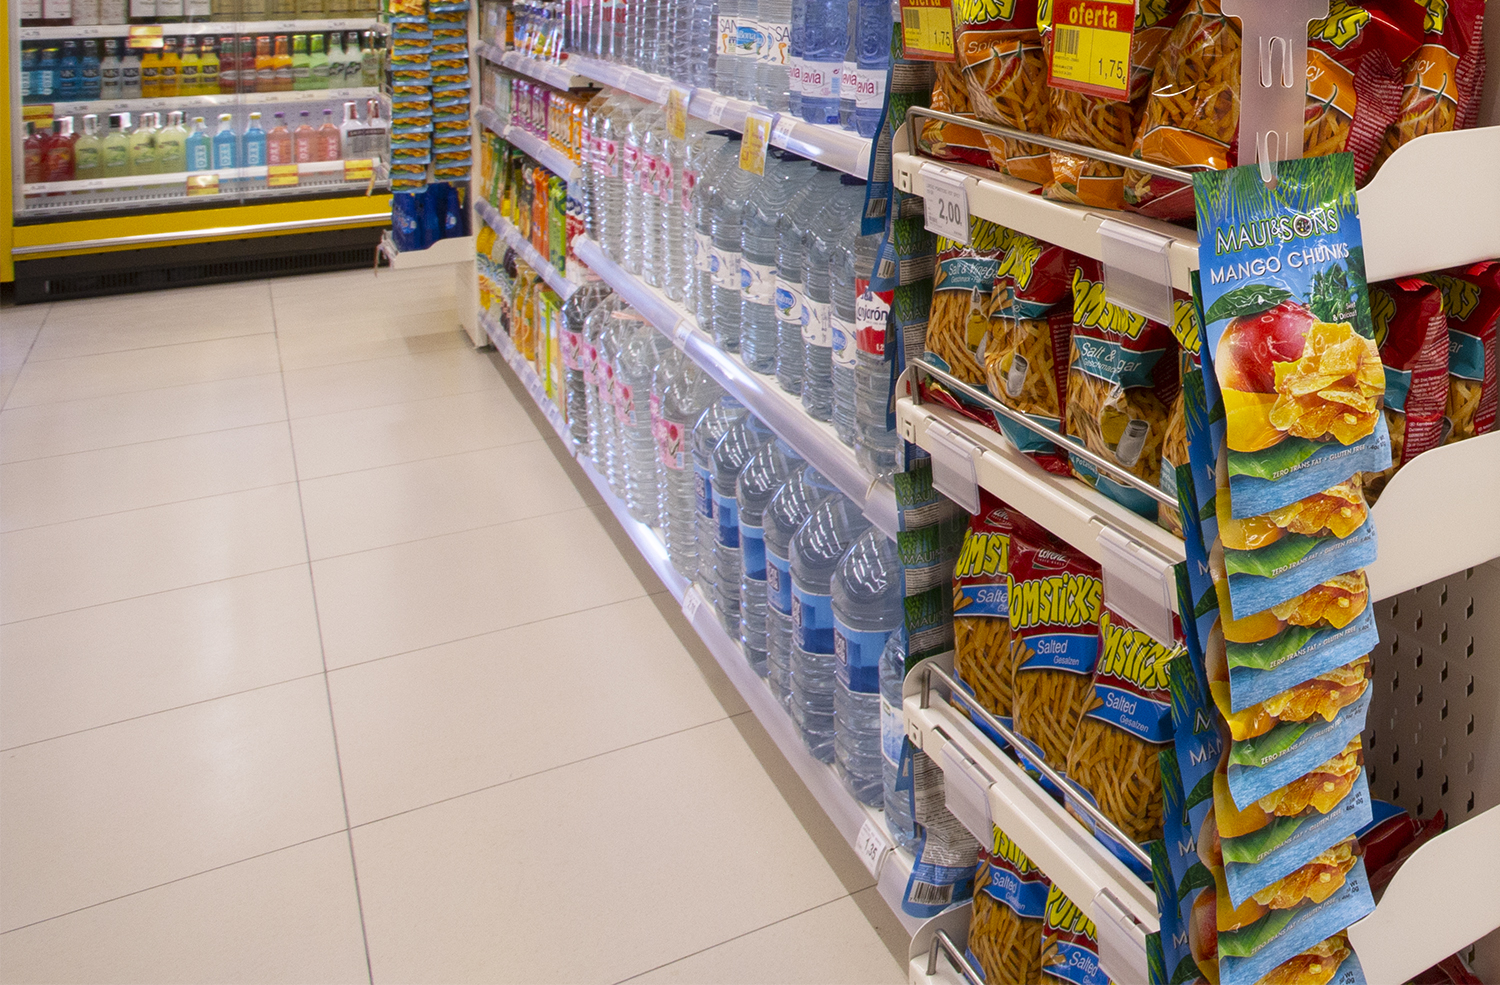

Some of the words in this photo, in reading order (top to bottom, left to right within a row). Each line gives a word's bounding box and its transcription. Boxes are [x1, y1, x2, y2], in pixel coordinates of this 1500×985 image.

[1069, 2, 1118, 28] oferta
[1210, 256, 1281, 285] MANGO
[1287, 243, 1350, 268] CHUNKS
[1081, 342, 1102, 360] Salt
[1272, 468, 1289, 479] ZERO
[1290, 460, 1311, 473] TRANS
[1311, 456, 1323, 467] FAT
[1329, 447, 1352, 461] GLUTEN
[1353, 443, 1366, 454] FREE
[1272, 564, 1288, 576] ZERO
[1324, 540, 1346, 554] GLUTEN
[1346, 535, 1360, 545] FREE
[1037, 640, 1068, 655] Salted
[1270, 656, 1286, 669] ZERO
[1286, 647, 1307, 661] TRANS
[1307, 643, 1317, 653] FAT
[1323, 632, 1344, 647] GLUTEN
[1345, 625, 1357, 636] FREE
[1053, 655, 1080, 666] Gesalzen
[1106, 692, 1137, 715] Salted
[1119, 714, 1149, 733] Gesalzen
[992, 871, 1018, 894] Salted
[1069, 951, 1098, 978] Salted
